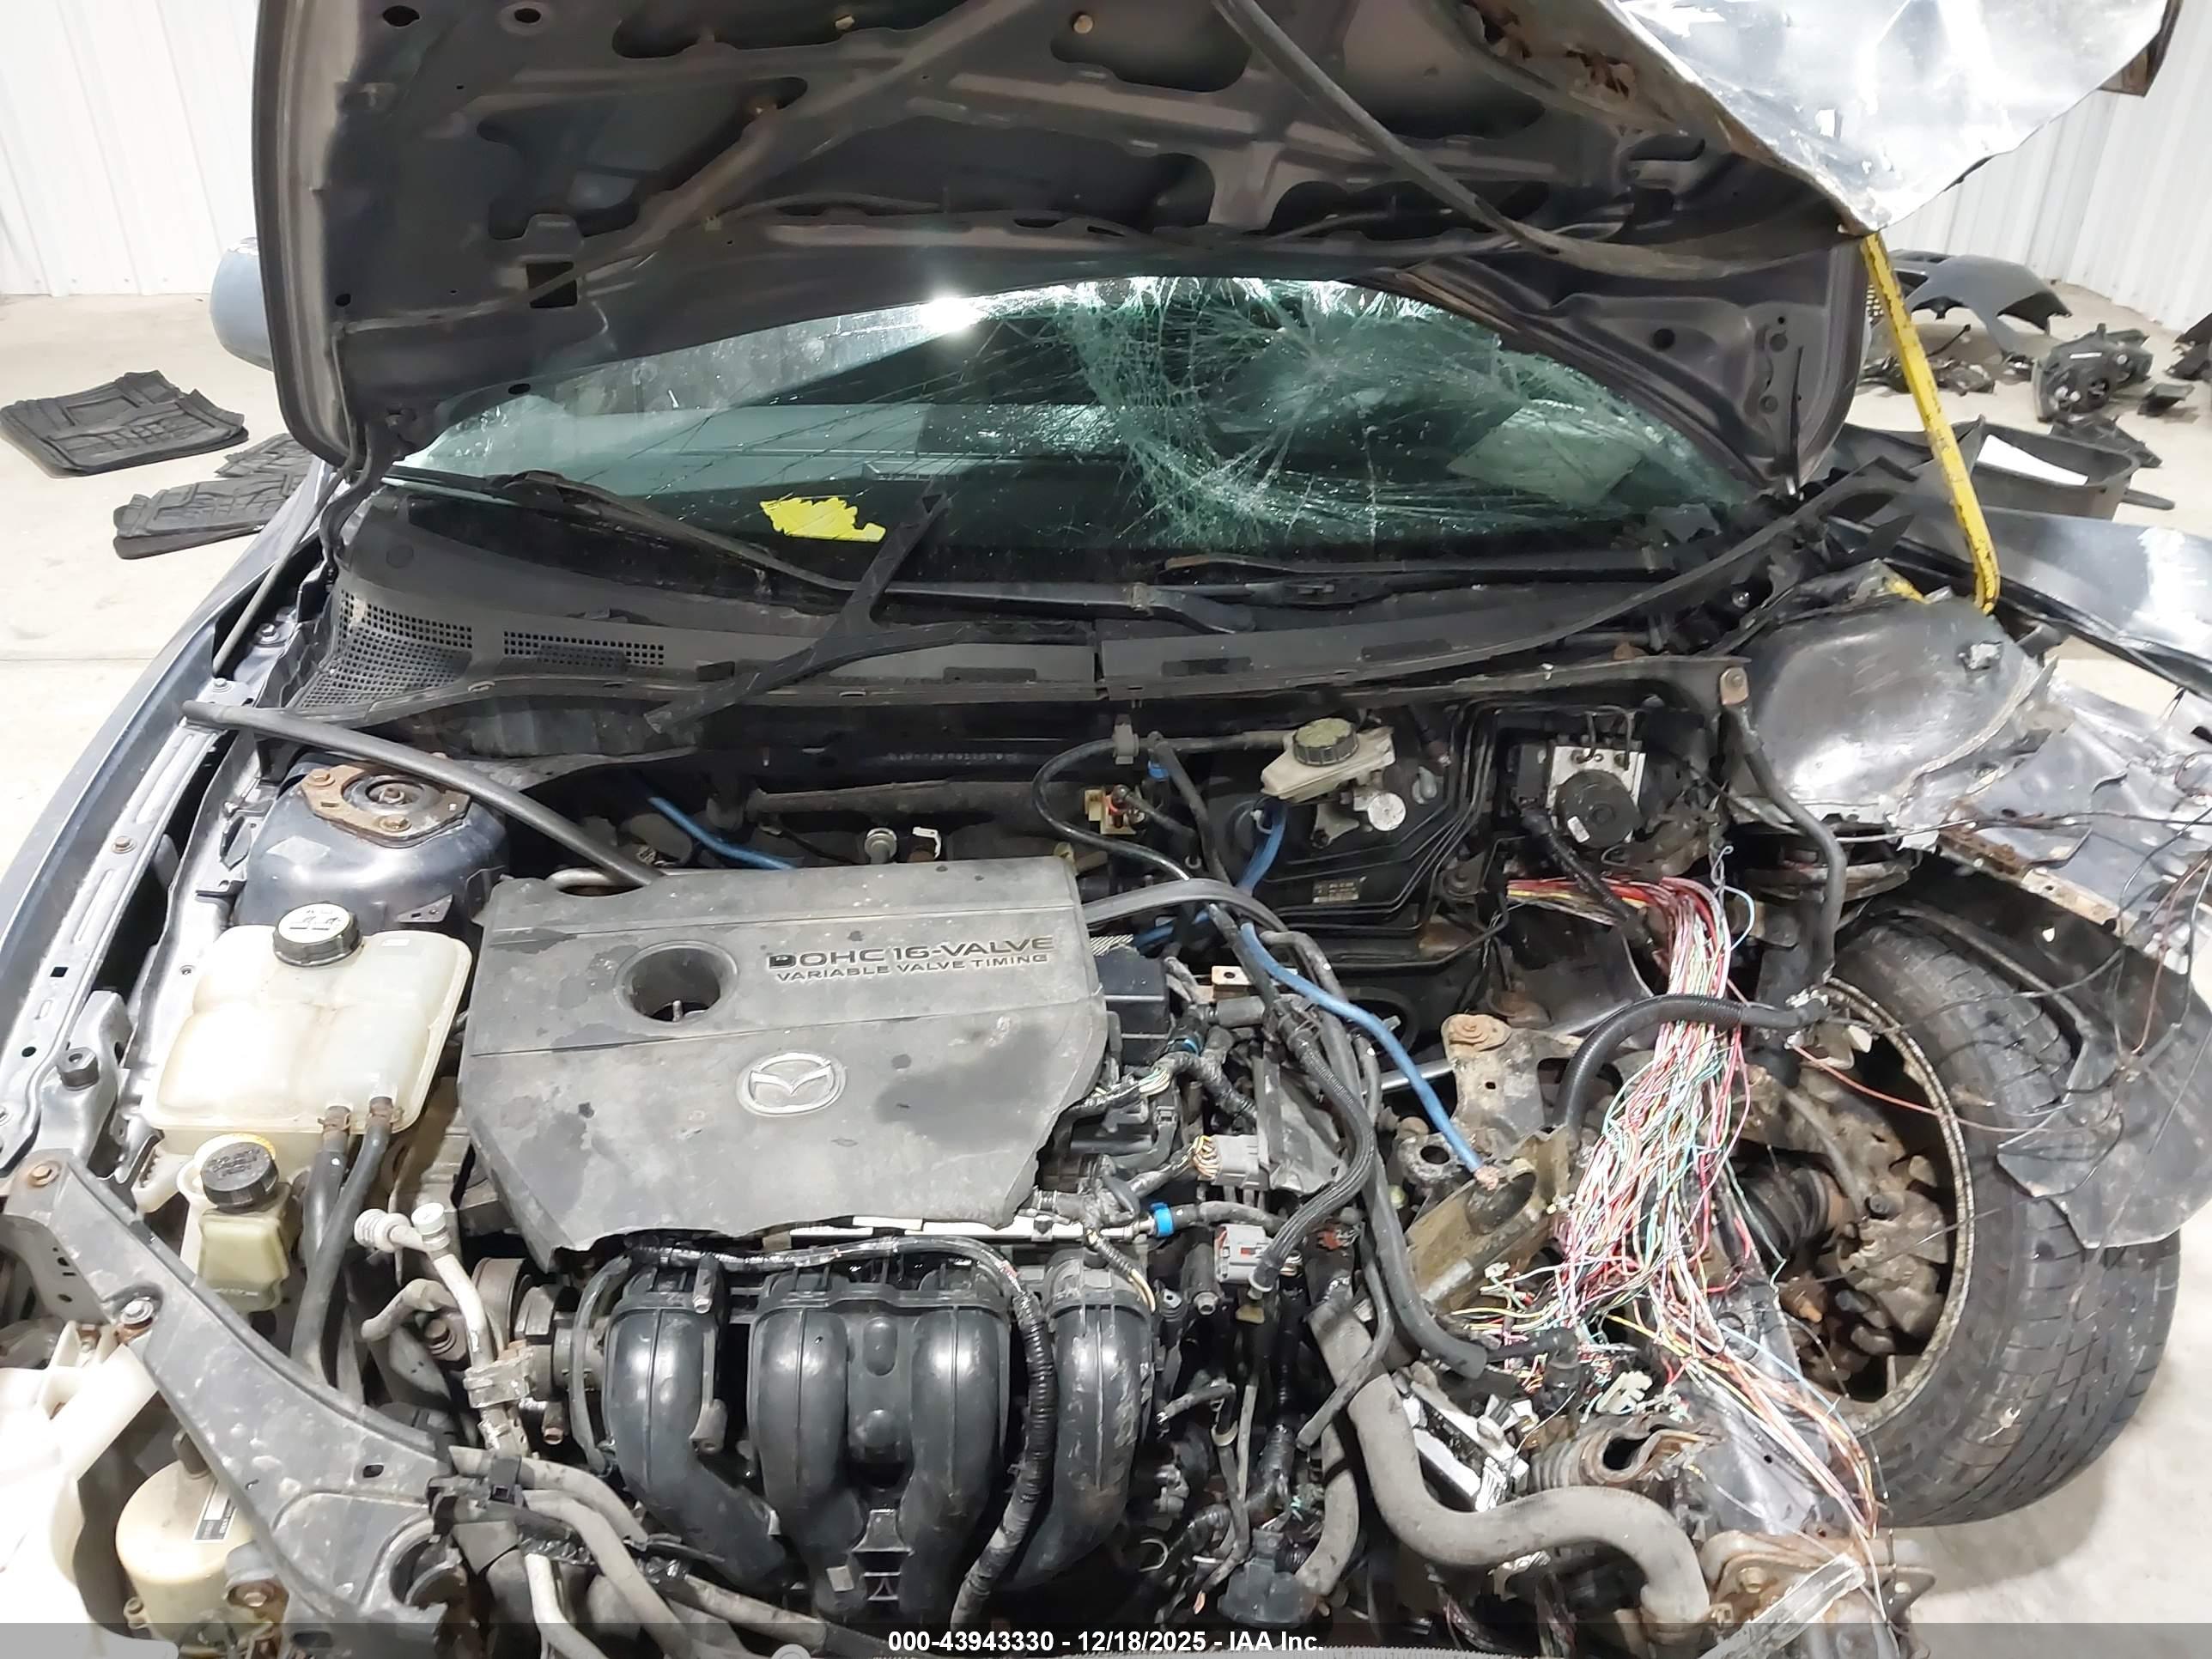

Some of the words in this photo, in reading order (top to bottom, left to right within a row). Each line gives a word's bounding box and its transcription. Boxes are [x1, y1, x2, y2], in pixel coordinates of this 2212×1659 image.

[893, 937, 1054, 961] 16-VALVE
[777, 965, 889, 982] VARIABLE
[897, 960, 965, 973] VALVE
[970, 954, 1048, 968] TIMING
